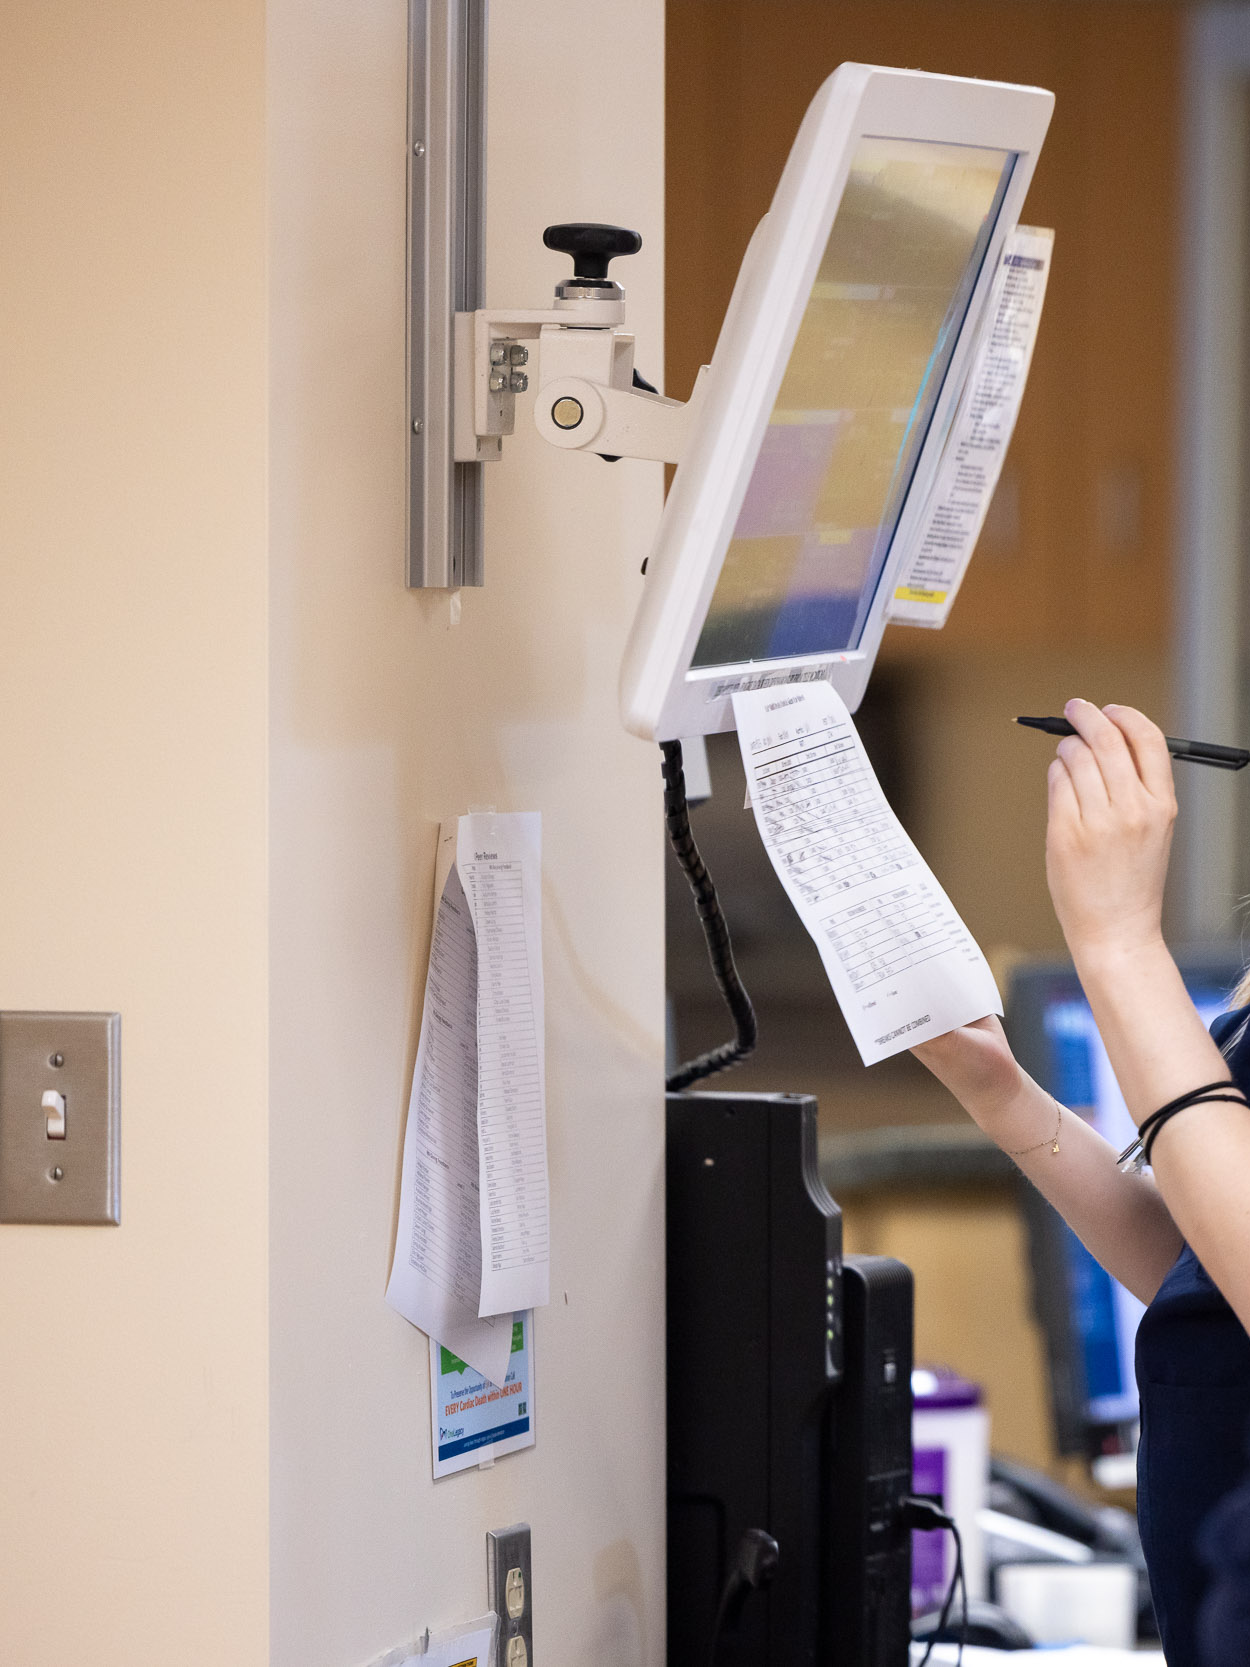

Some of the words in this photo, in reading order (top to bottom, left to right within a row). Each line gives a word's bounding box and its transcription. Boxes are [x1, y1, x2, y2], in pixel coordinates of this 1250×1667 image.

[445, 1402, 460, 1417] EVERY
[459, 1398, 475, 1412] Cardiac
[474, 1394, 488, 1407] Death
[487, 1390, 500, 1402] within
[509, 1381, 523, 1394] HOUR
